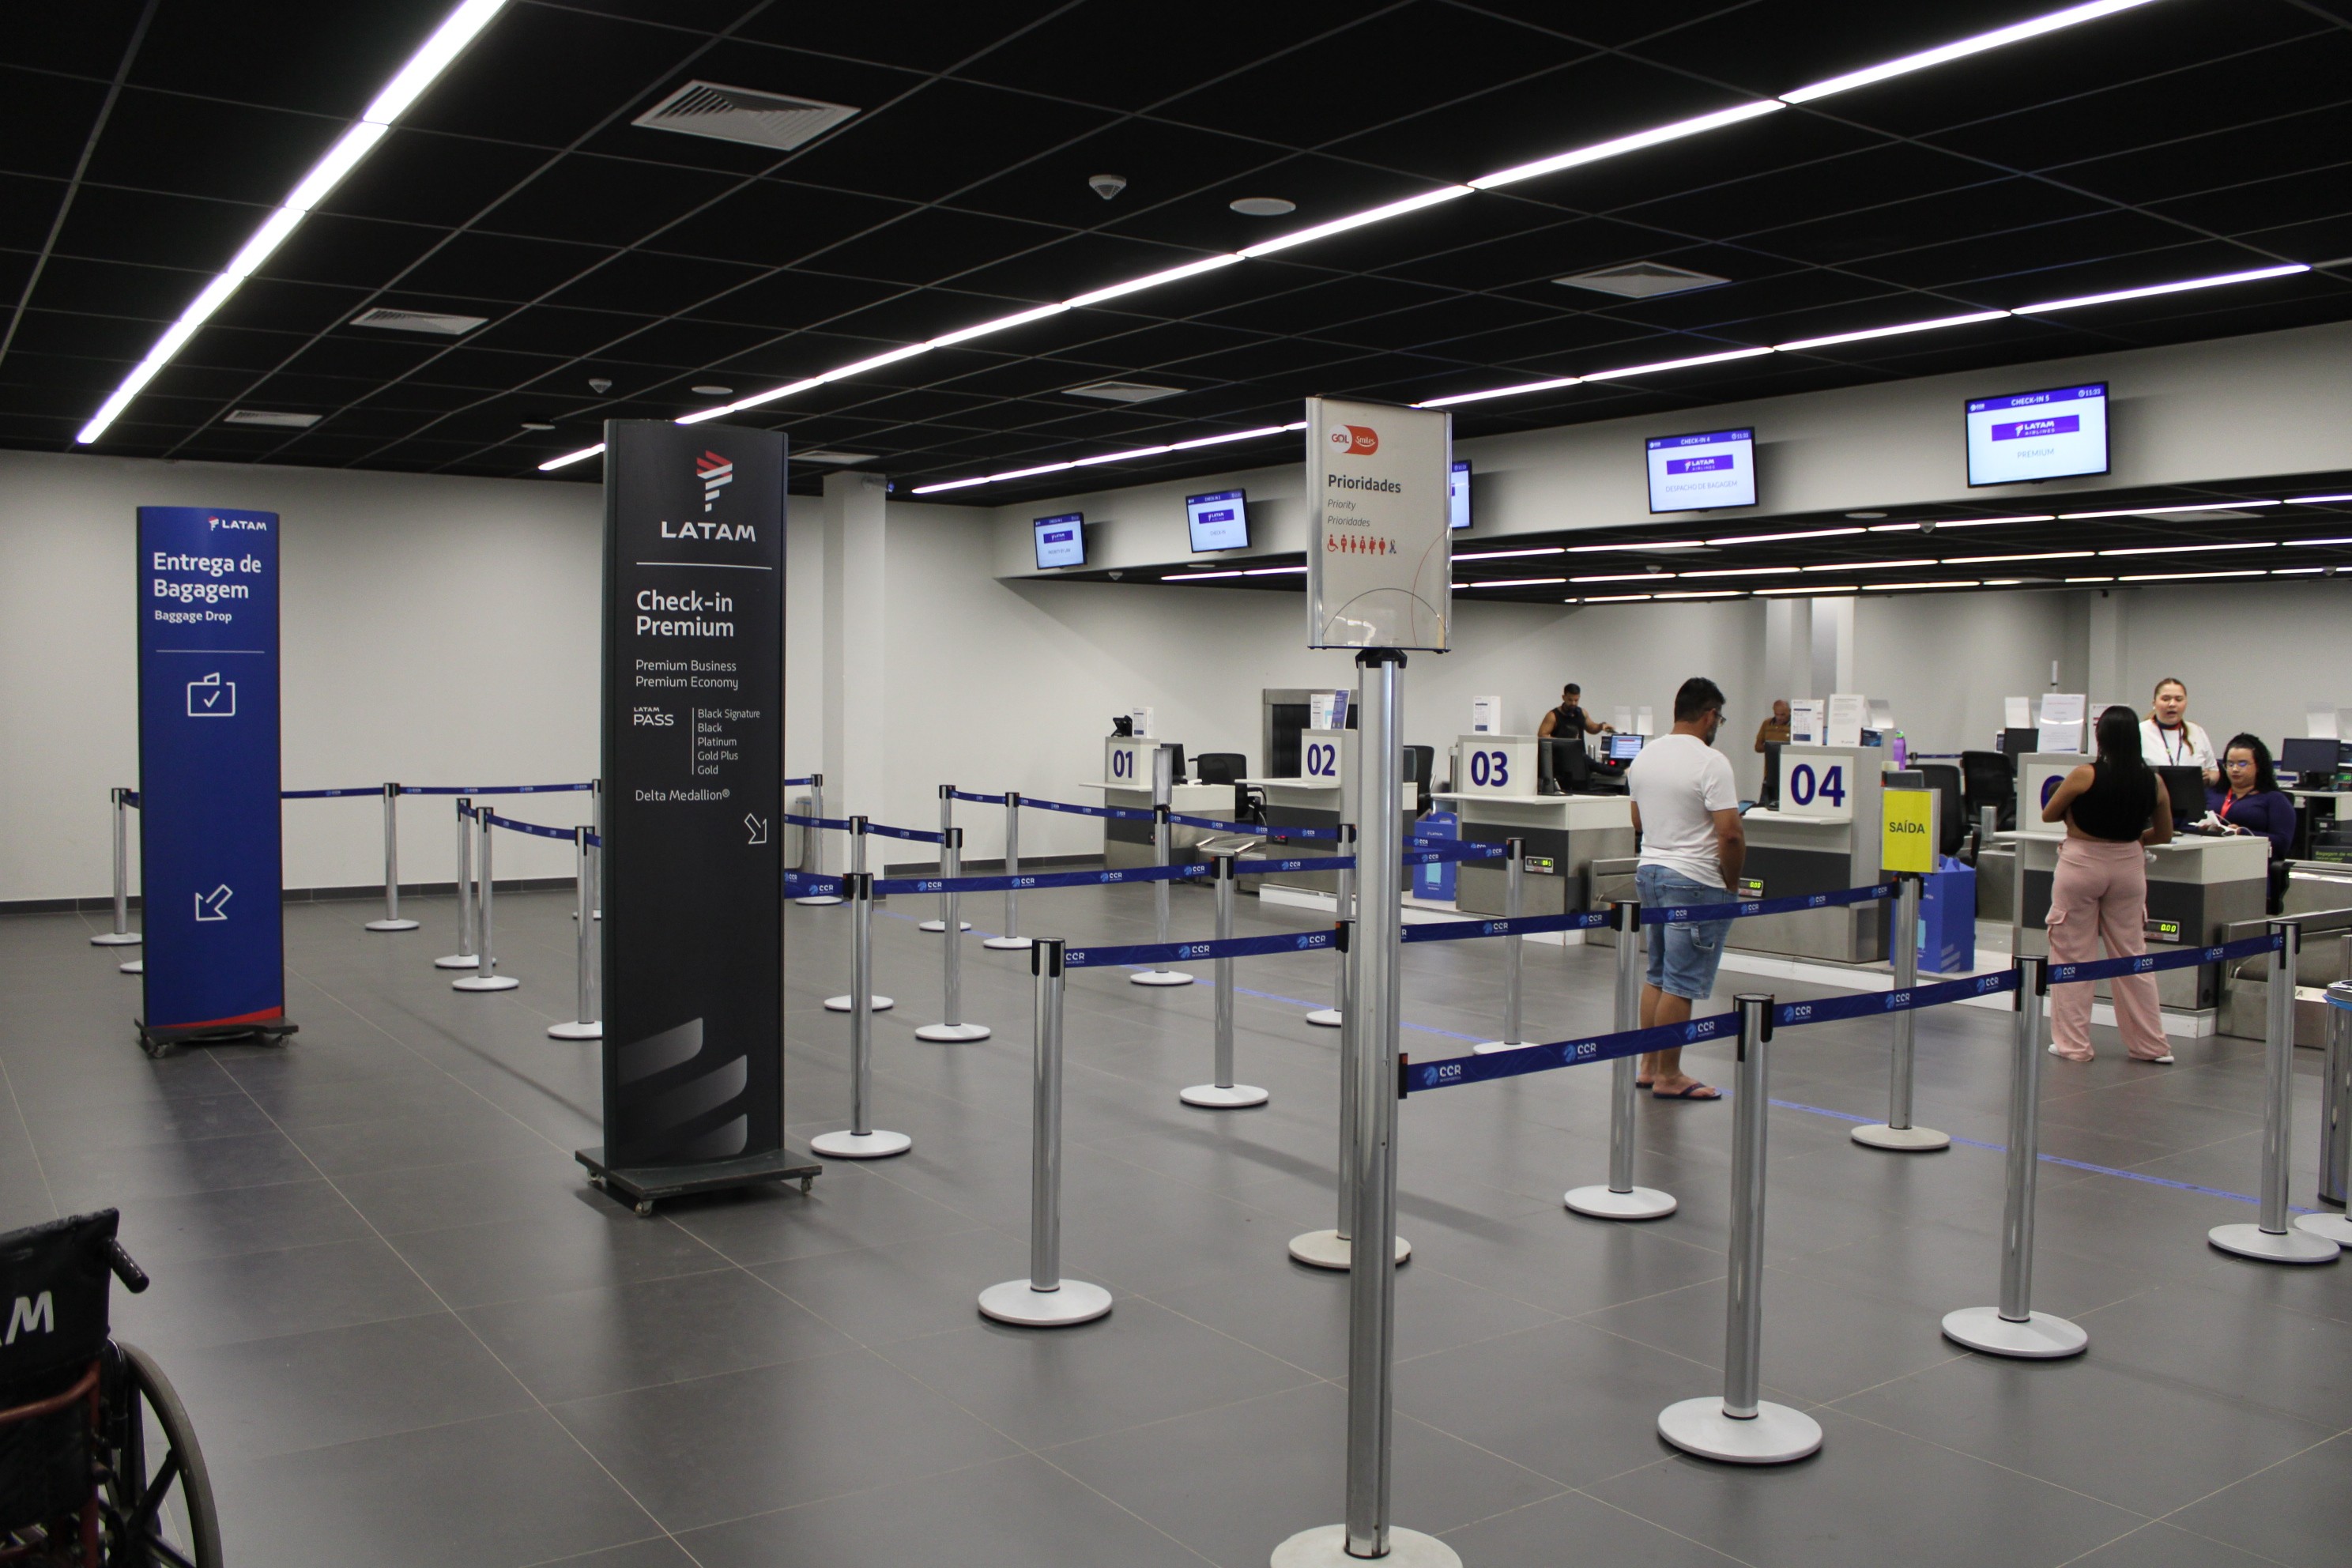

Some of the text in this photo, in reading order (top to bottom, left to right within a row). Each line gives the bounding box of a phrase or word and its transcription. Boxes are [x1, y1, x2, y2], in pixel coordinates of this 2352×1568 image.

[2011, 395, 2045, 406] CHECK-IN
[2024, 420, 2055, 430] LATAM
[1332, 433, 1375, 444] GOL Smiles
[2017, 448, 2055, 459] PREMIUM
[1328, 474, 1401, 493] Prioridades
[1665, 484, 1697, 492] DESPACHO
[1707, 481, 1738, 489] BAGAGEM
[1328, 499, 1356, 511] Priority
[222, 519, 267, 531] LATAM
[1328, 515, 1370, 527] Prioridades
[661, 521, 756, 542] LATAM
[153, 552, 262, 577] Entrega de
[153, 579, 249, 603] Bagagem
[636, 590, 733, 612] Check-in
[154, 610, 232, 624] Baggage Drop
[636, 616, 734, 637] Premium
[635, 659, 737, 672] Premium Business
[635, 676, 739, 691] Premium Economy
[633, 714, 674, 726] PASS
[698, 709, 760, 720] Black Signature
[698, 723, 722, 733] Black
[698, 737, 737, 746] Platinum
[698, 751, 739, 760] Gold Plus
[1307, 744, 1336, 776] 02
[1113, 749, 1133, 778] 01
[1471, 751, 1509, 787] 03
[698, 765, 718, 775] Gold
[1790, 763, 1845, 808] 04
[635, 790, 666, 801] Delta
[1889, 820, 1925, 834] SAÍDA
[1309, 935, 1326, 944] CCR
[1192, 944, 1210, 953] CCR
[1065, 952, 1085, 961] CCR
[2141, 958, 2154, 967] CCR
[2063, 967, 2075, 975] CCR
[1985, 977, 1999, 986] CCR
[1896, 993, 1910, 1002] CCR
[1795, 1005, 1811, 1016] CCR
[1698, 1021, 1715, 1032] CCR
[1577, 1042, 1596, 1054] CCR
[1439, 1064, 1461, 1077] CCR
[0, 1290, 55, 1347] M
